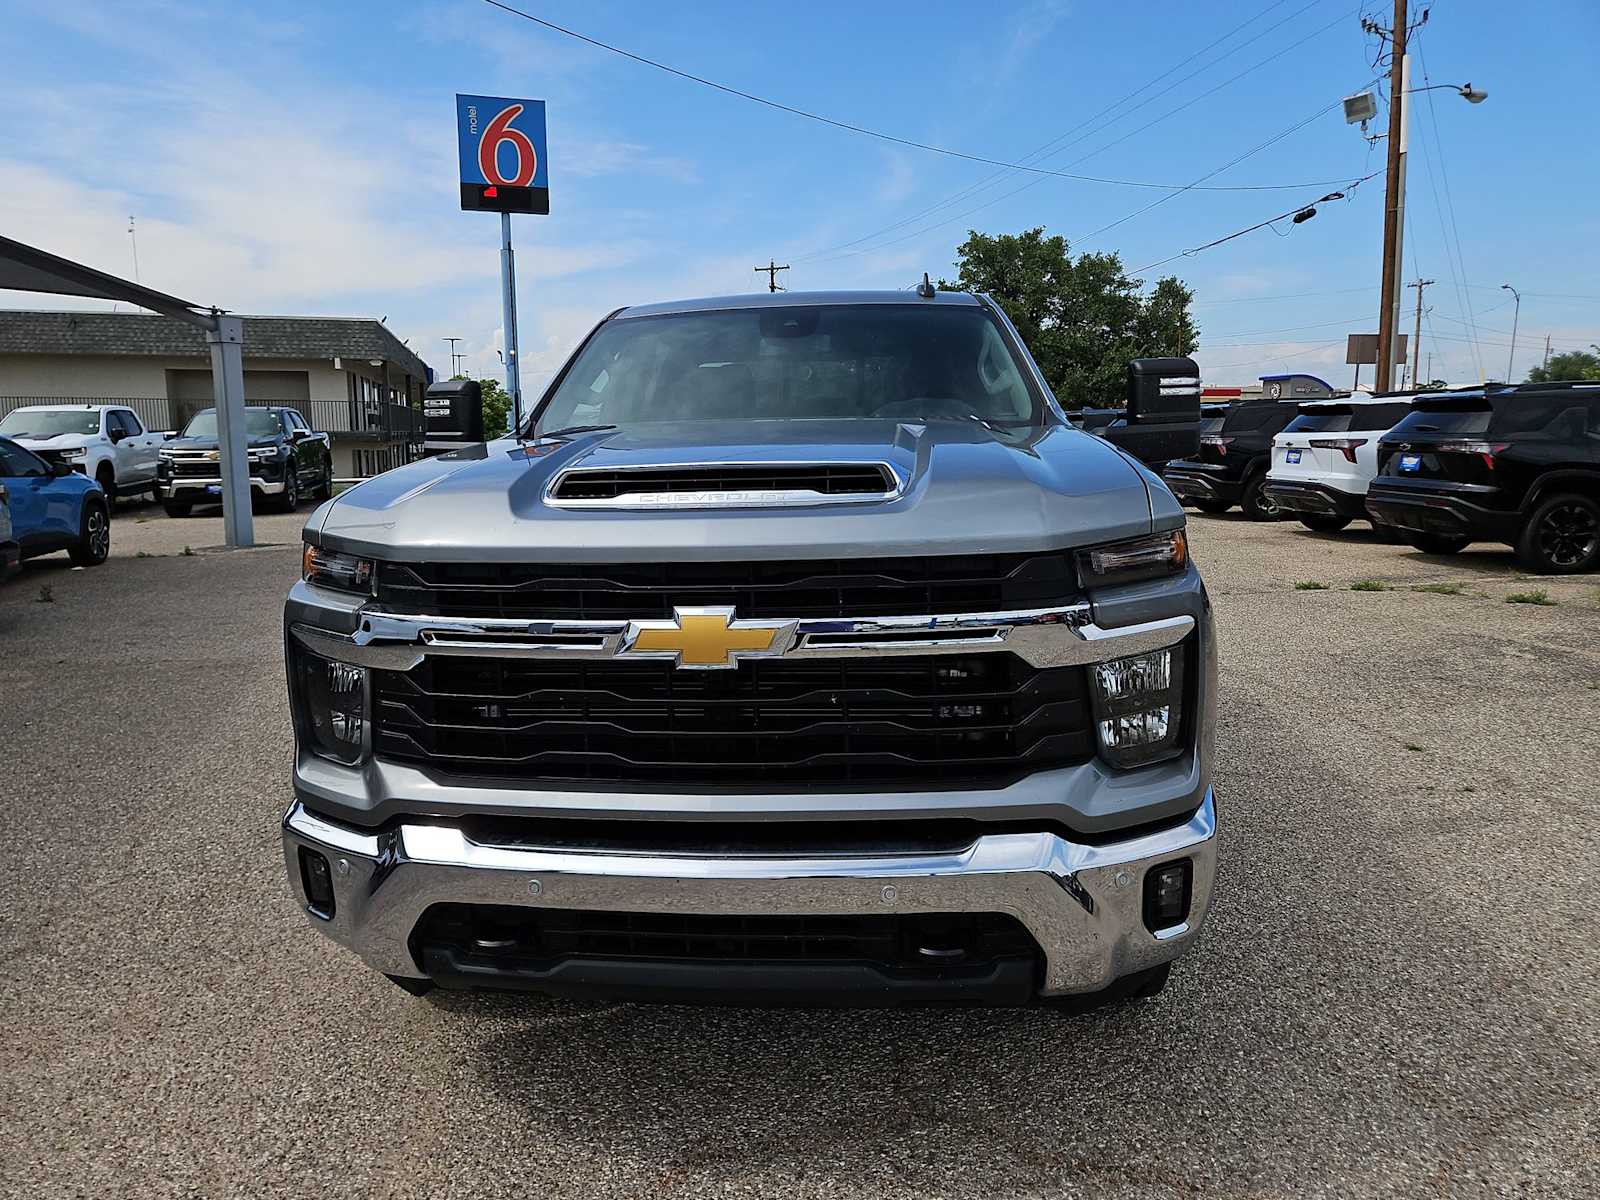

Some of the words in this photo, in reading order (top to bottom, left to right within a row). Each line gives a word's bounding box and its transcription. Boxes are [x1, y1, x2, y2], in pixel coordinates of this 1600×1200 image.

[467, 105, 478, 135] motel
[477, 103, 538, 187] 6
[639, 491, 786, 504] CHEVROLET
